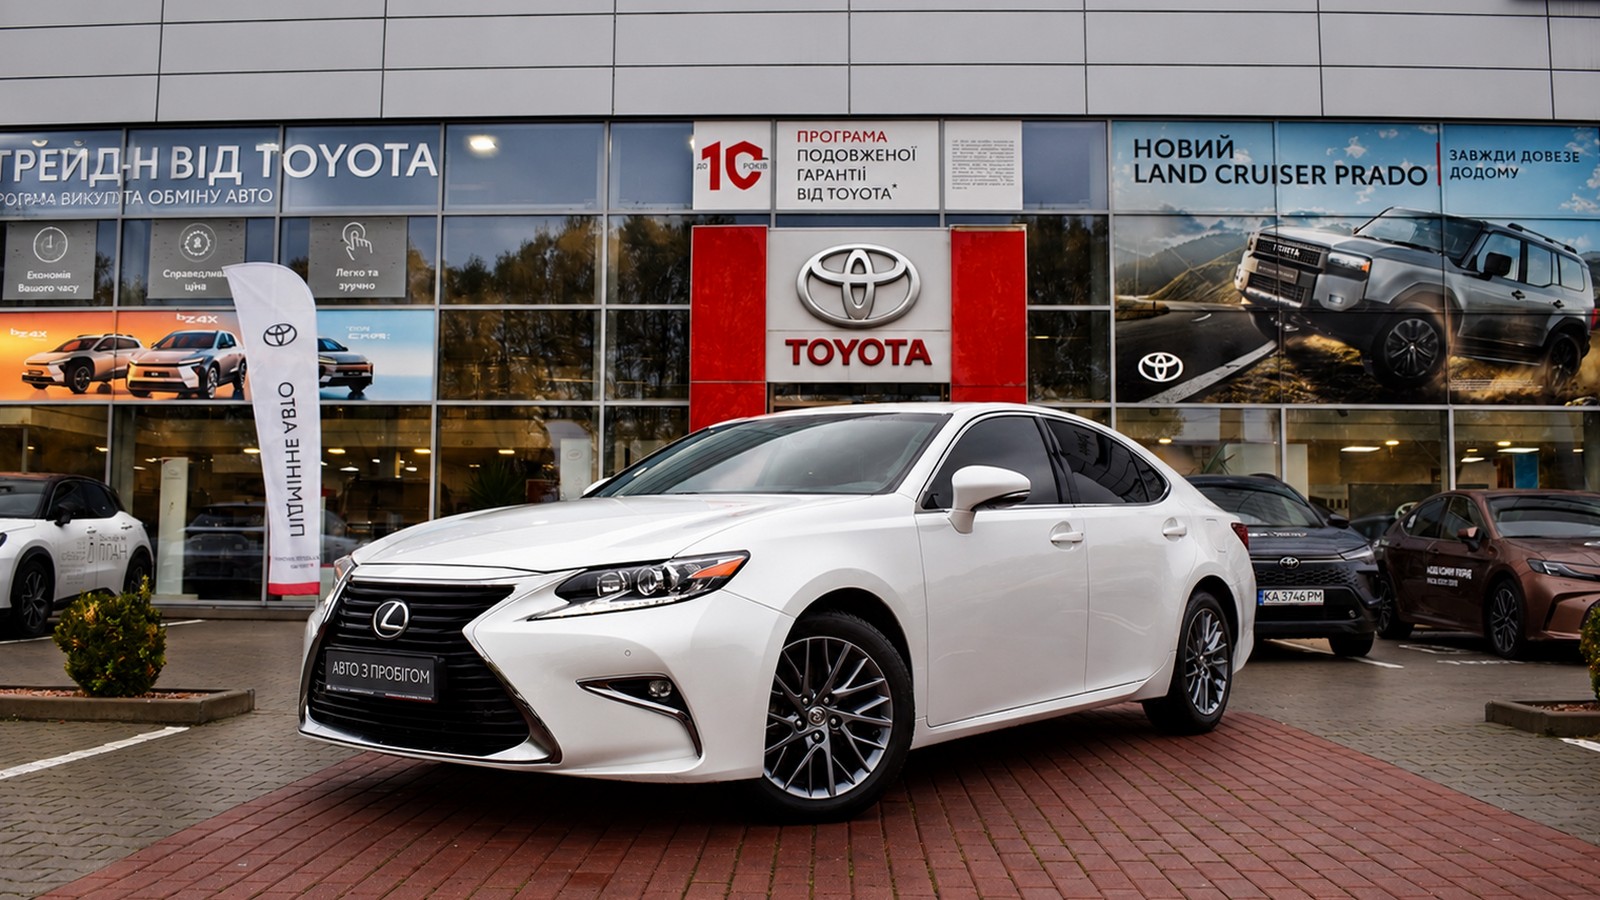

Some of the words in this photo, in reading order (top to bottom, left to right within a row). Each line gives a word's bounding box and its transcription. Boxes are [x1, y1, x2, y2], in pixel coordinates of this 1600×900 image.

[797, 130, 887, 143] ПРОГРАМА
[797, 146, 917, 164] ПОДОВЖЕНОЇ
[1134, 134, 1233, 158] НОВИЙ
[170, 145, 242, 186] ВІД
[256, 143, 438, 178] TOYOTA
[1450, 150, 1516, 162] ЗАВЖДИ
[1521, 150, 1580, 163] ДОВЕЗЕ
[1135, 164, 1207, 183] LAND
[1215, 164, 1327, 185] CRUISER
[1335, 165, 1428, 186] PRADO
[1449, 167, 1519, 180] ДОДОМУ
[124, 190, 144, 204] ТА
[148, 189, 221, 204] ОБМІНУ
[225, 188, 273, 203] АВТО
[797, 188, 823, 202] ВІД
[368, 269, 379, 277] та
[785, 338, 932, 366] TOYOTA
[278, 381, 297, 434] АВТО
[285, 438, 305, 537] ПІДМІННЕ
[1264, 591, 1279, 601] KA
[1281, 591, 1306, 602] 3746
[1307, 591, 1323, 601] PM
[332, 661, 359, 677] АВТО
[370, 664, 430, 684] ПРОБІГОМ
